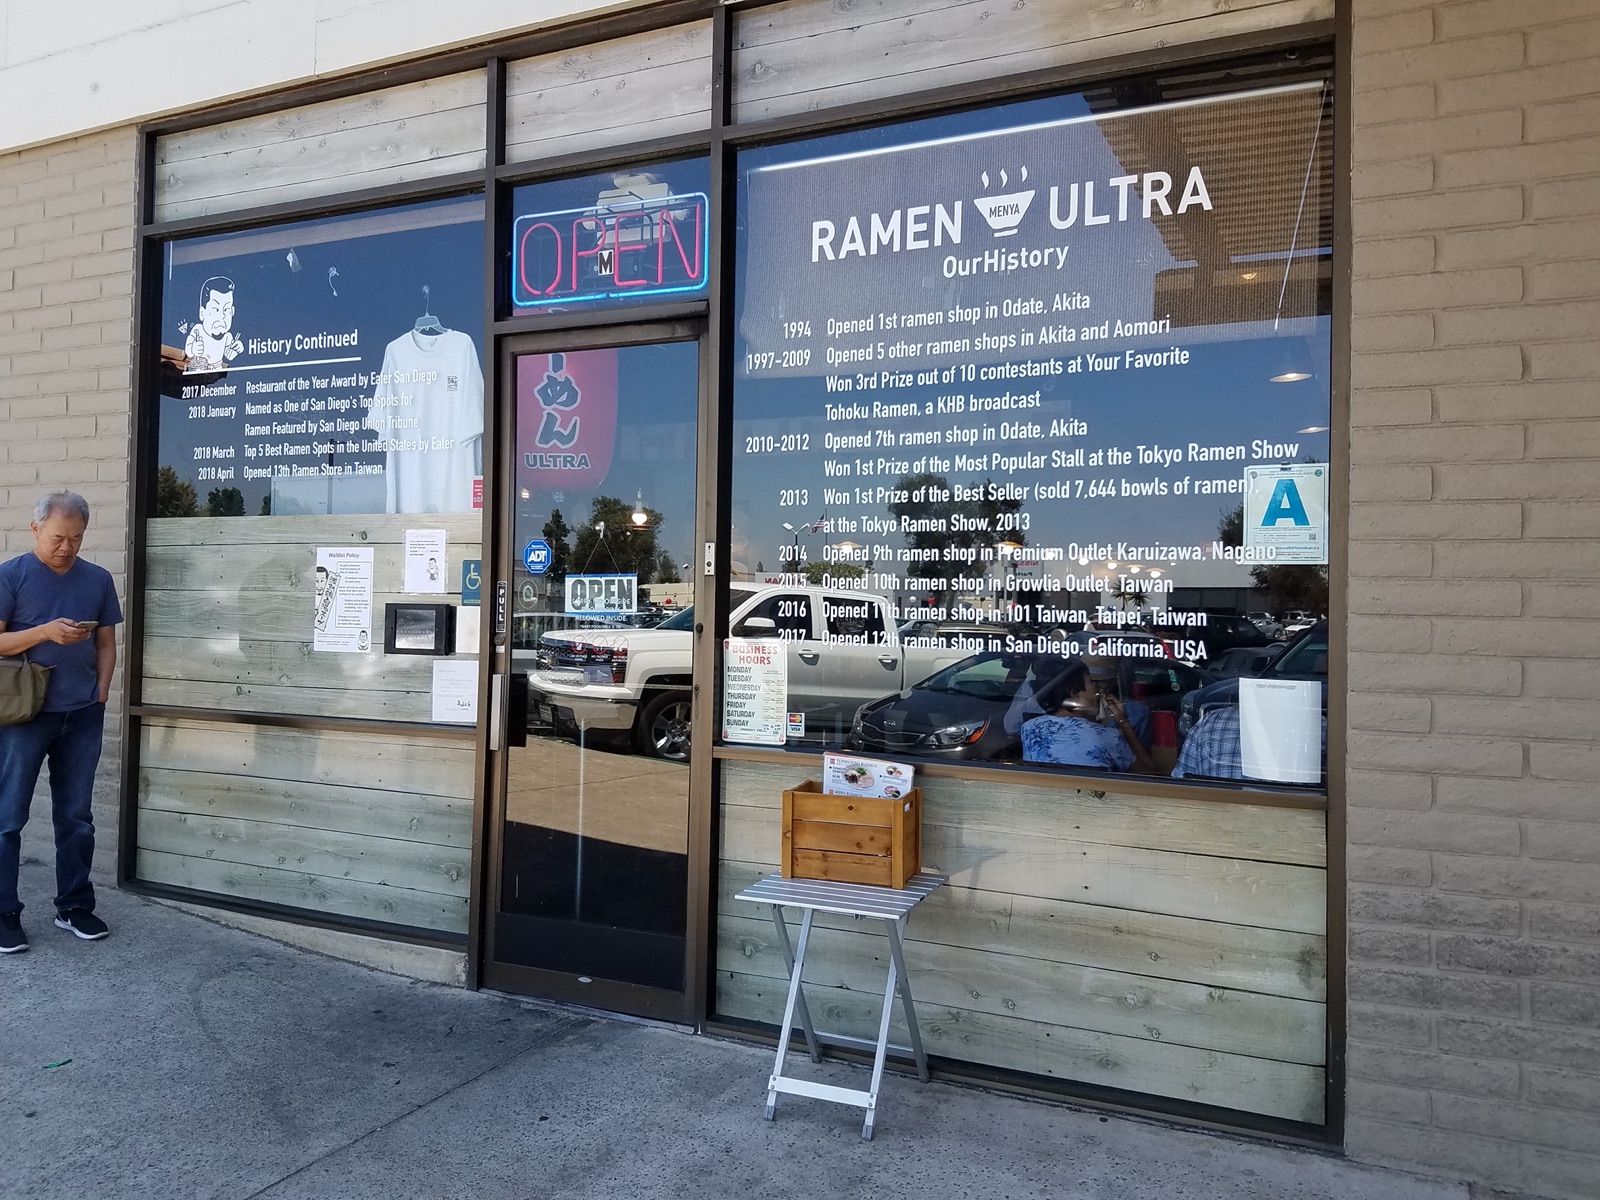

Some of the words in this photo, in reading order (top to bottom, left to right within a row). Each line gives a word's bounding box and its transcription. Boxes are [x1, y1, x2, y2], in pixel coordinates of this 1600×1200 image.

[812, 200, 962, 263] RAMEN
[989, 204, 1020, 218] MENYA
[1050, 166, 1213, 230] ULTRA
[520, 203, 700, 295] OPEN
[600, 251, 613, 274] M
[784, 322, 811, 339] 1994
[827, 314, 874, 338] Opened
[878, 312, 897, 329] 1st
[900, 310, 943, 327] ramen
[947, 304, 980, 324] shop
[985, 302, 998, 319] in
[1002, 298, 1047, 317] Odate,
[1051, 293, 1090, 312] Akita
[248, 336, 291, 354] History
[294, 329, 358, 349] Continued
[748, 349, 811, 370] 1997-2009
[826, 343, 872, 366] Opened
[876, 341, 884, 358] 5
[888, 339, 922, 357] other
[926, 337, 969, 354] ramen
[974, 332, 1016, 351] shops
[1020, 328, 1034, 345] in
[1038, 325, 1075, 344] Akita
[1080, 321, 1108, 340] and
[1113, 315, 1169, 337] Aomori
[182, 386, 199, 399] 2017
[200, 384, 237, 397] December
[245, 379, 286, 393] Restaurant
[287, 378, 296, 390] of
[297, 377, 309, 390] the
[310, 376, 329, 389] Year
[330, 374, 354, 388] Award
[358, 373, 368, 388] by
[370, 372, 391, 385] Eater
[393, 371, 410, 383] San
[412, 369, 436, 384] Diego
[188, 406, 206, 419] 2018
[206, 405, 236, 418] January
[245, 400, 271, 414] Named
[272, 402, 282, 412] as
[284, 399, 298, 412] One
[300, 398, 309, 411] of
[310, 398, 326, 410] San
[327, 395, 357, 411] Diego's
[358, 395, 372, 410] Top
[375, 394, 398, 409] Spots
[400, 392, 412, 405] for
[244, 423, 270, 435] Ramen
[272, 420, 306, 434] Featured
[307, 420, 317, 435] by
[319, 419, 334, 432] San
[336, 418, 359, 433] Diego
[361, 417, 385, 430] Union
[387, 415, 418, 428] Tribune
[746, 434, 810, 453] 2010-2012
[824, 429, 870, 452] Opened
[875, 428, 894, 445] 7th
[899, 429, 941, 444] ramen
[945, 424, 978, 444] shop
[982, 422, 995, 439] in
[1000, 421, 1045, 439] Odate,
[1049, 418, 1087, 436] Akita
[193, 448, 211, 460] 2018
[212, 446, 235, 459] March
[243, 444, 257, 459] Top
[258, 443, 264, 456] 5
[265, 443, 282, 456] Best
[283, 442, 310, 455] Ramen
[312, 441, 334, 456] Spots
[336, 440, 344, 453] in
[346, 440, 359, 452] the
[361, 439, 387, 452] United
[389, 438, 416, 451] States
[419, 437, 428, 452] by
[431, 437, 454, 449] Eater
[198, 468, 216, 480] 2018
[216, 467, 234, 481] April
[243, 465, 271, 481] Opened
[273, 464, 290, 477] 13th
[292, 464, 319, 477] Ramen
[320, 463, 342, 475] Store
[344, 462, 352, 475] in
[353, 461, 382, 474] Taiwan
[524, 453, 590, 469] ULTRA
[780, 490, 808, 506] 2013
[824, 487, 849, 504] Won
[854, 486, 873, 503] 1st
[876, 485, 908, 502] Prize
[912, 484, 926, 501] of
[928, 484, 949, 501] the
[954, 483, 984, 500] Best
[987, 482, 1029, 499] Seller
[1034, 480, 1070, 501] (sold
[1074, 479, 1116, 499] 7,644
[1121, 478, 1168, 496] bowls
[1173, 477, 1190, 494] of
[1260, 479, 1311, 526] A
[346, 552, 360, 560] Policy
[528, 550, 546, 562] ADT
[778, 546, 808, 562] 2014
[822, 544, 869, 564] Opened
[872, 543, 892, 560] 9th
[896, 547, 939, 560] ramen
[942, 543, 976, 564] shop
[980, 543, 993, 560] in
[997, 543, 1063, 560] Premium
[1068, 543, 1112, 560] Outlet
[1117, 542, 1205, 562] Karuizawa,
[1212, 542, 1276, 564] Nagano
[571, 579, 632, 610] OPEN
[778, 573, 807, 589] 2015
[822, 572, 868, 593] Opened
[873, 573, 900, 589] 10th
[904, 576, 946, 590] ramen
[950, 573, 984, 594] shop
[988, 573, 1001, 590] in
[1005, 573, 1060, 590] Growlia
[1065, 573, 1113, 593] Outlet,
[1118, 574, 1173, 591] Taiwan
[778, 629, 806, 645] 2017
[820, 629, 867, 650] Opened
[871, 630, 899, 648] 12th
[903, 635, 946, 649] ramen
[950, 633, 984, 655] shop
[988, 634, 1000, 651] in
[1005, 635, 1032, 652] San
[1037, 636, 1083, 658] Diego,
[1088, 638, 1168, 660] California,
[1173, 640, 1207, 659] USA
[739, 656, 772, 665] HOURS
[727, 683, 762, 692] WEDNESDAY
[727, 692, 756, 700] THURSDAY
